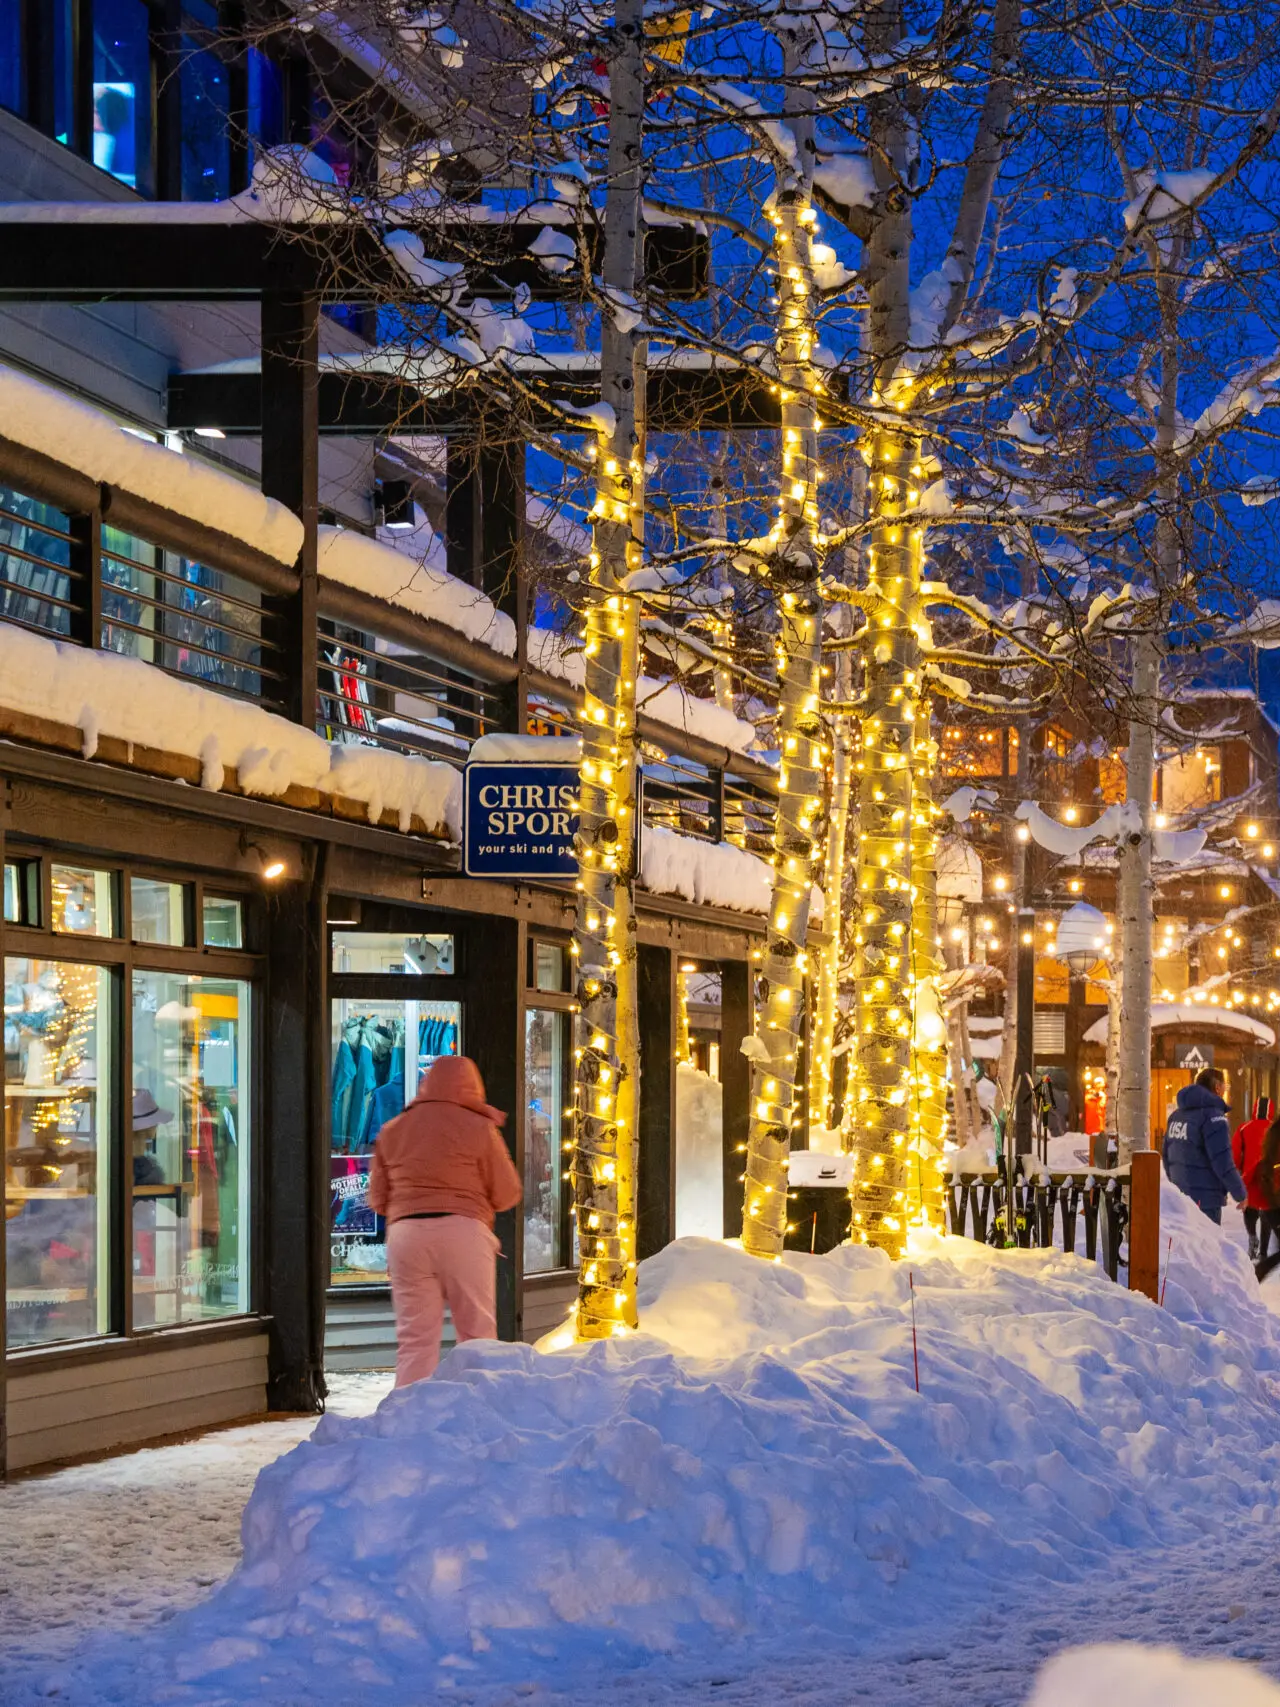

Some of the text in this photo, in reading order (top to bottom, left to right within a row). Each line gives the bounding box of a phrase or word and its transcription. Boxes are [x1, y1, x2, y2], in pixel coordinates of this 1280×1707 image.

[478, 785, 581, 809] CHRIS
[478, 843, 576, 856] your ski and pa
[1168, 1121, 1188, 1140] USA
